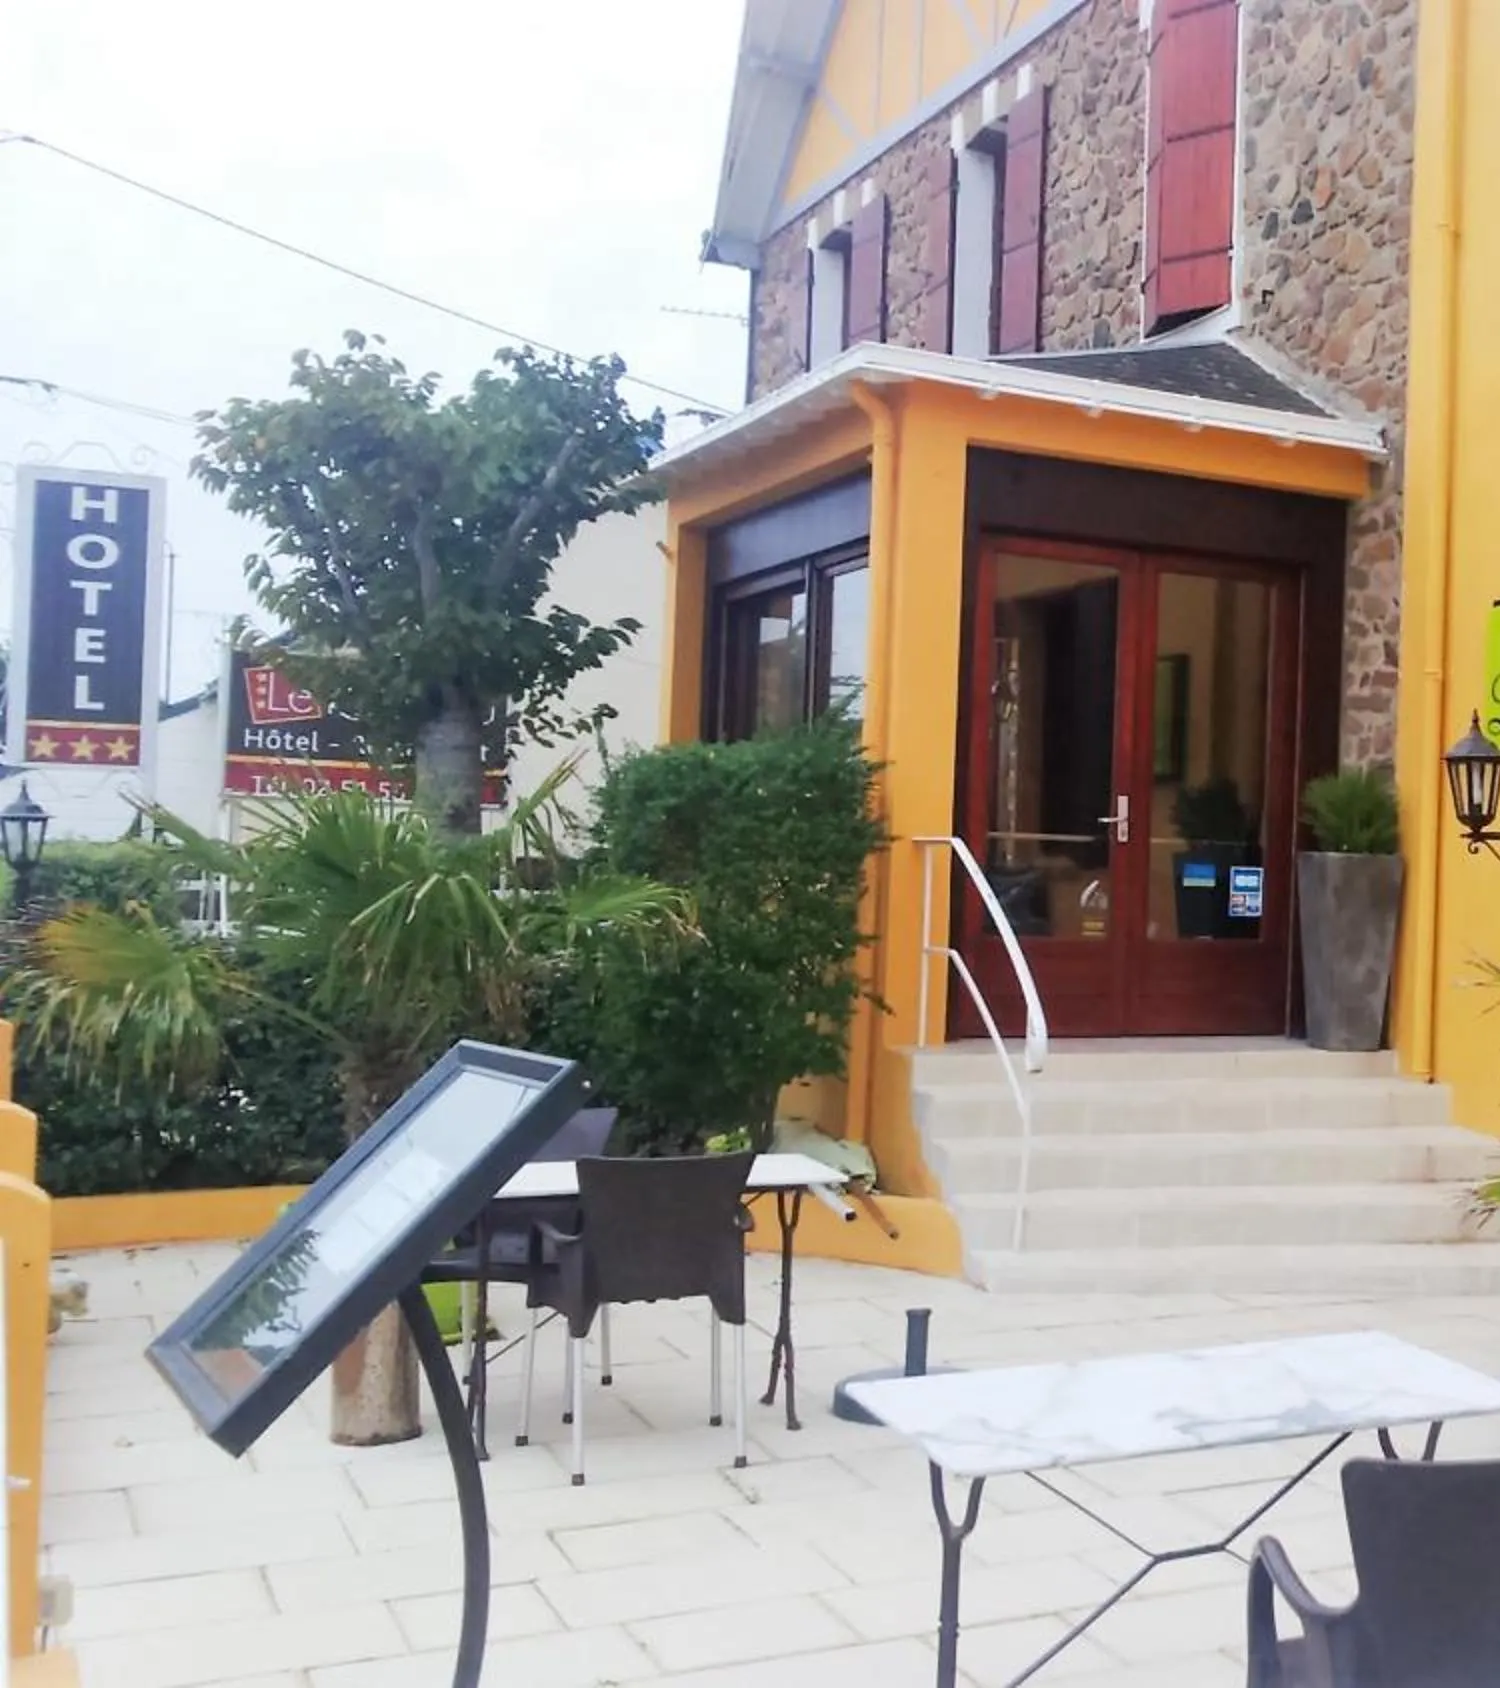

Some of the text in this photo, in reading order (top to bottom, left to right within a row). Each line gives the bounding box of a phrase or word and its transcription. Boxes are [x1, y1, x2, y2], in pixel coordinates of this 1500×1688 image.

[66, 485, 120, 711] HOTEL
[267, 671, 315, 714] Le
[243, 728, 319, 752] Hôtel
